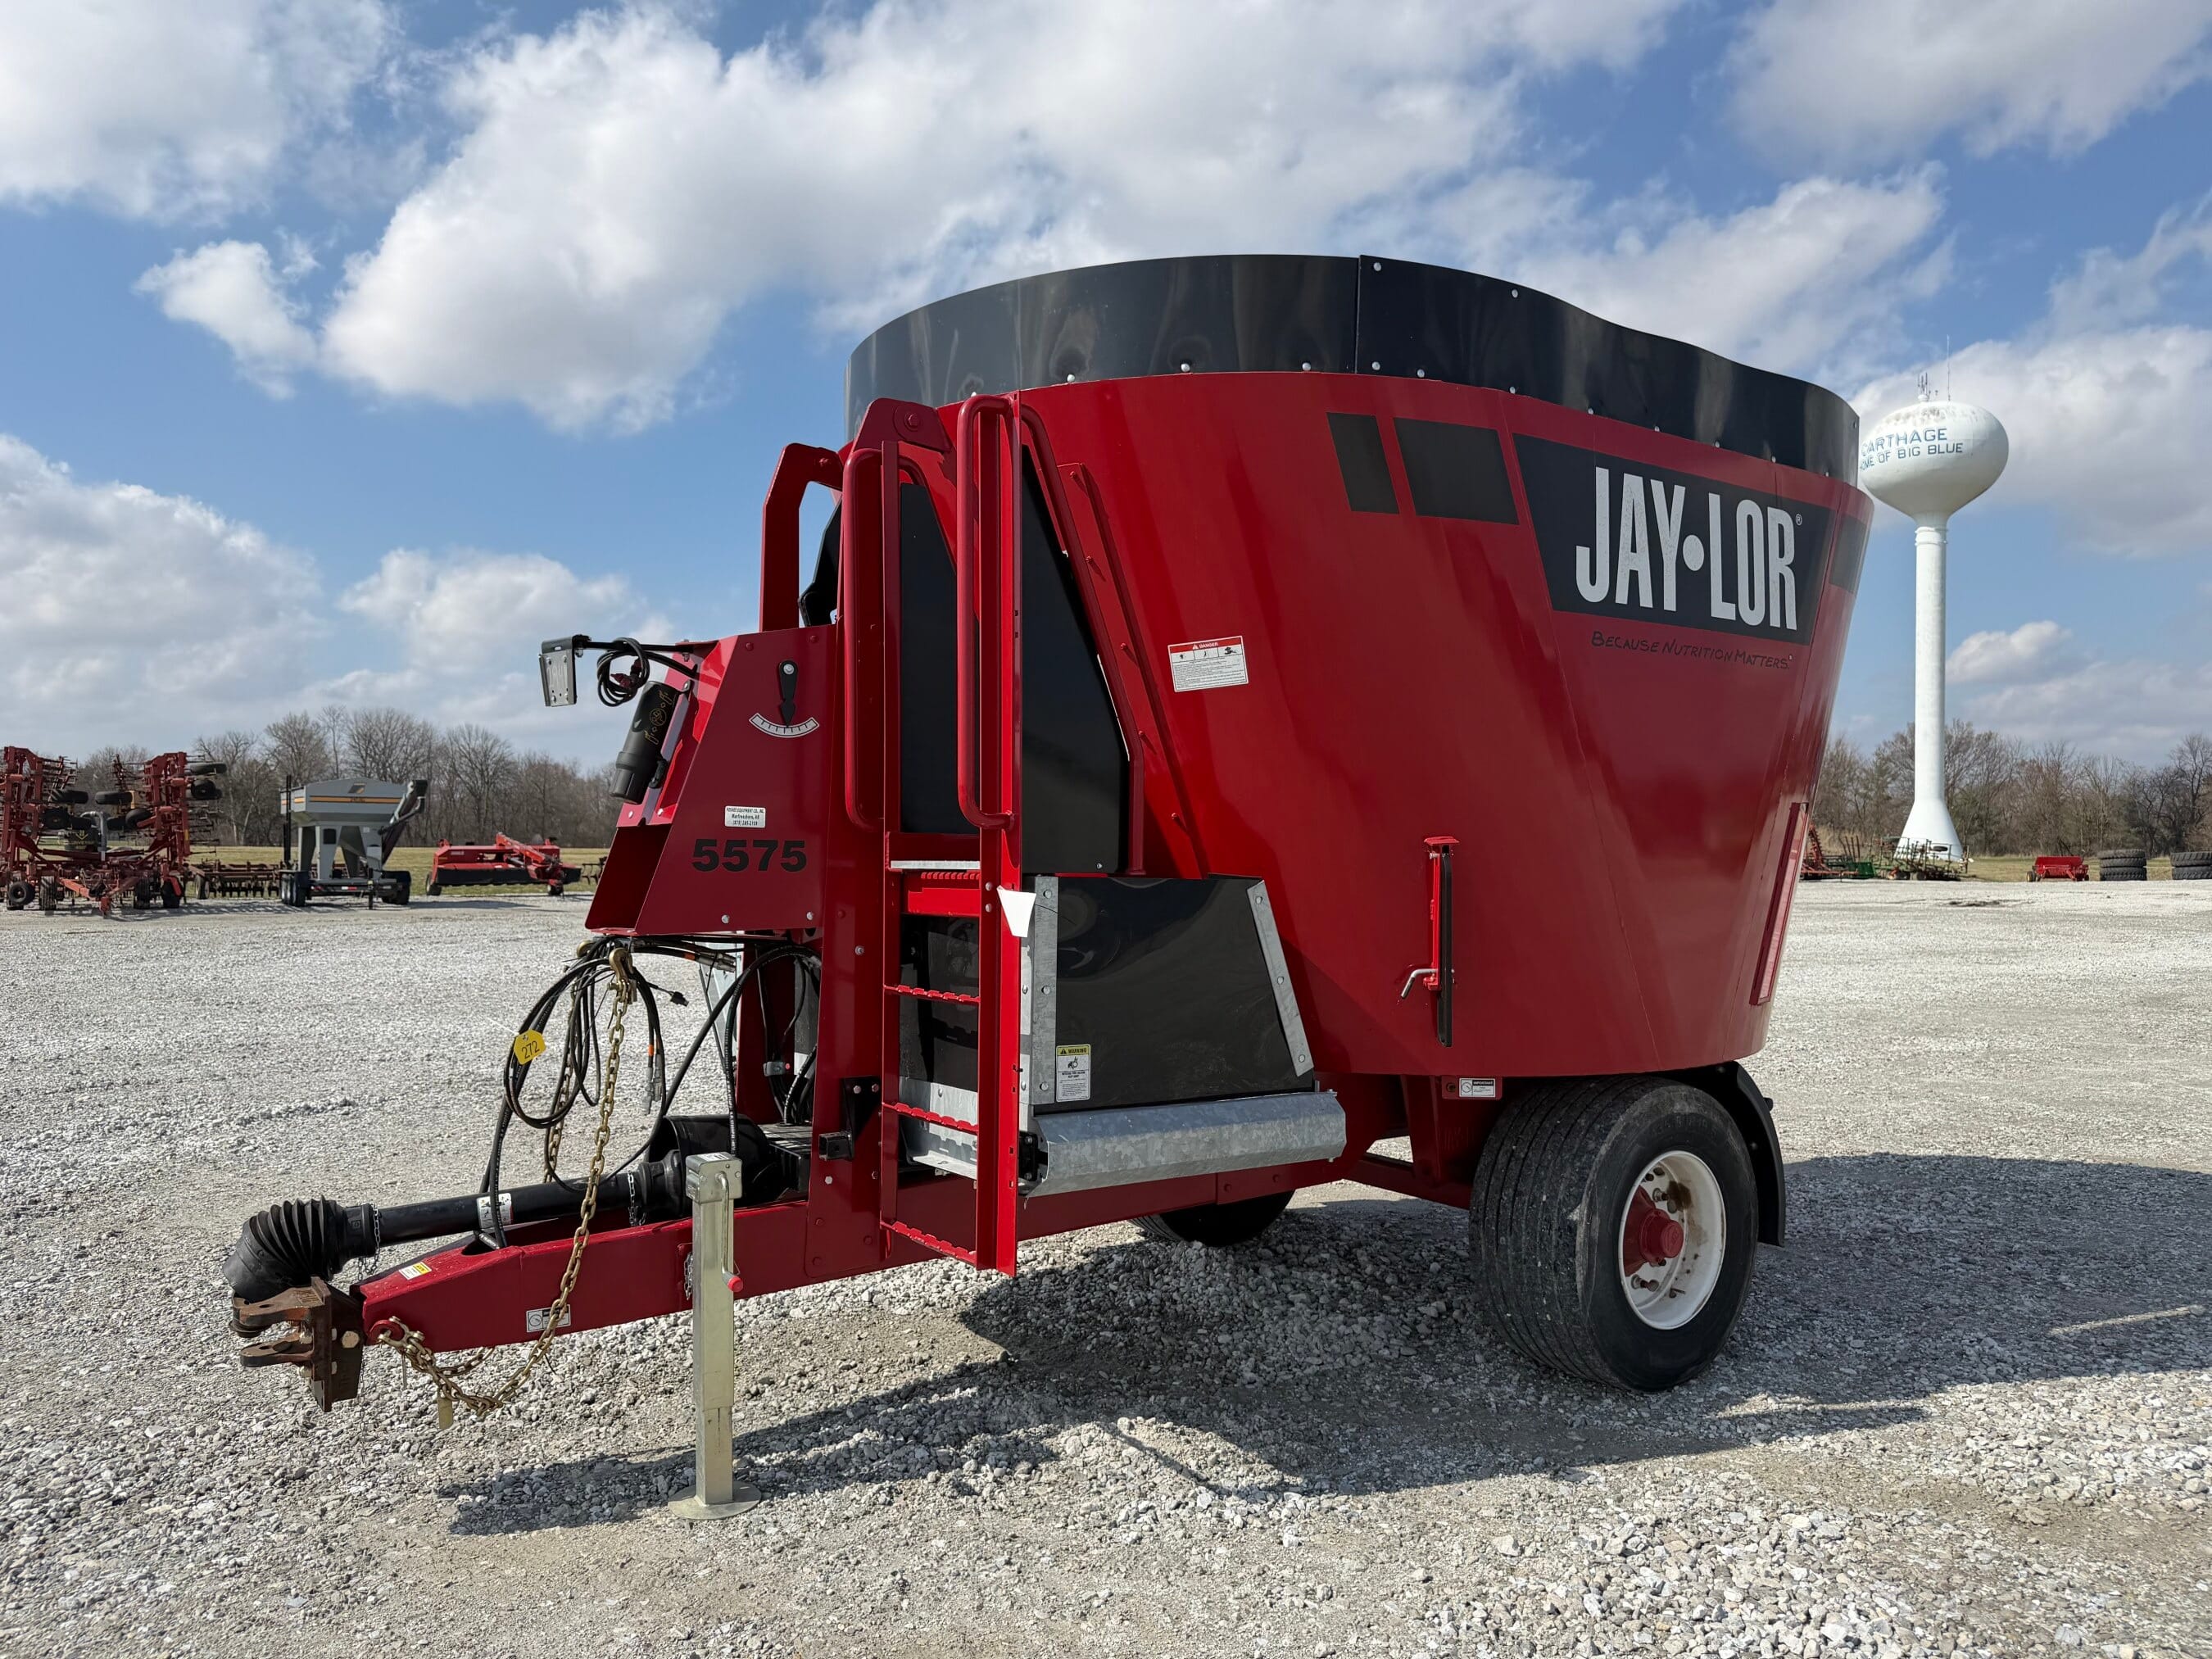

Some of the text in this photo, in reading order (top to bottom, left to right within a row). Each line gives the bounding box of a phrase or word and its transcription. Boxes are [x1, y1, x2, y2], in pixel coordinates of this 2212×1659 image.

[1861, 428, 1947, 456] CARTHAGE
[1878, 451, 1891, 464] OF
[1897, 446, 1920, 459] BIG
[1928, 442, 1963, 455] BLUE
[691, 839, 807, 872] 5575
[521, 1040, 540, 1059] 272
